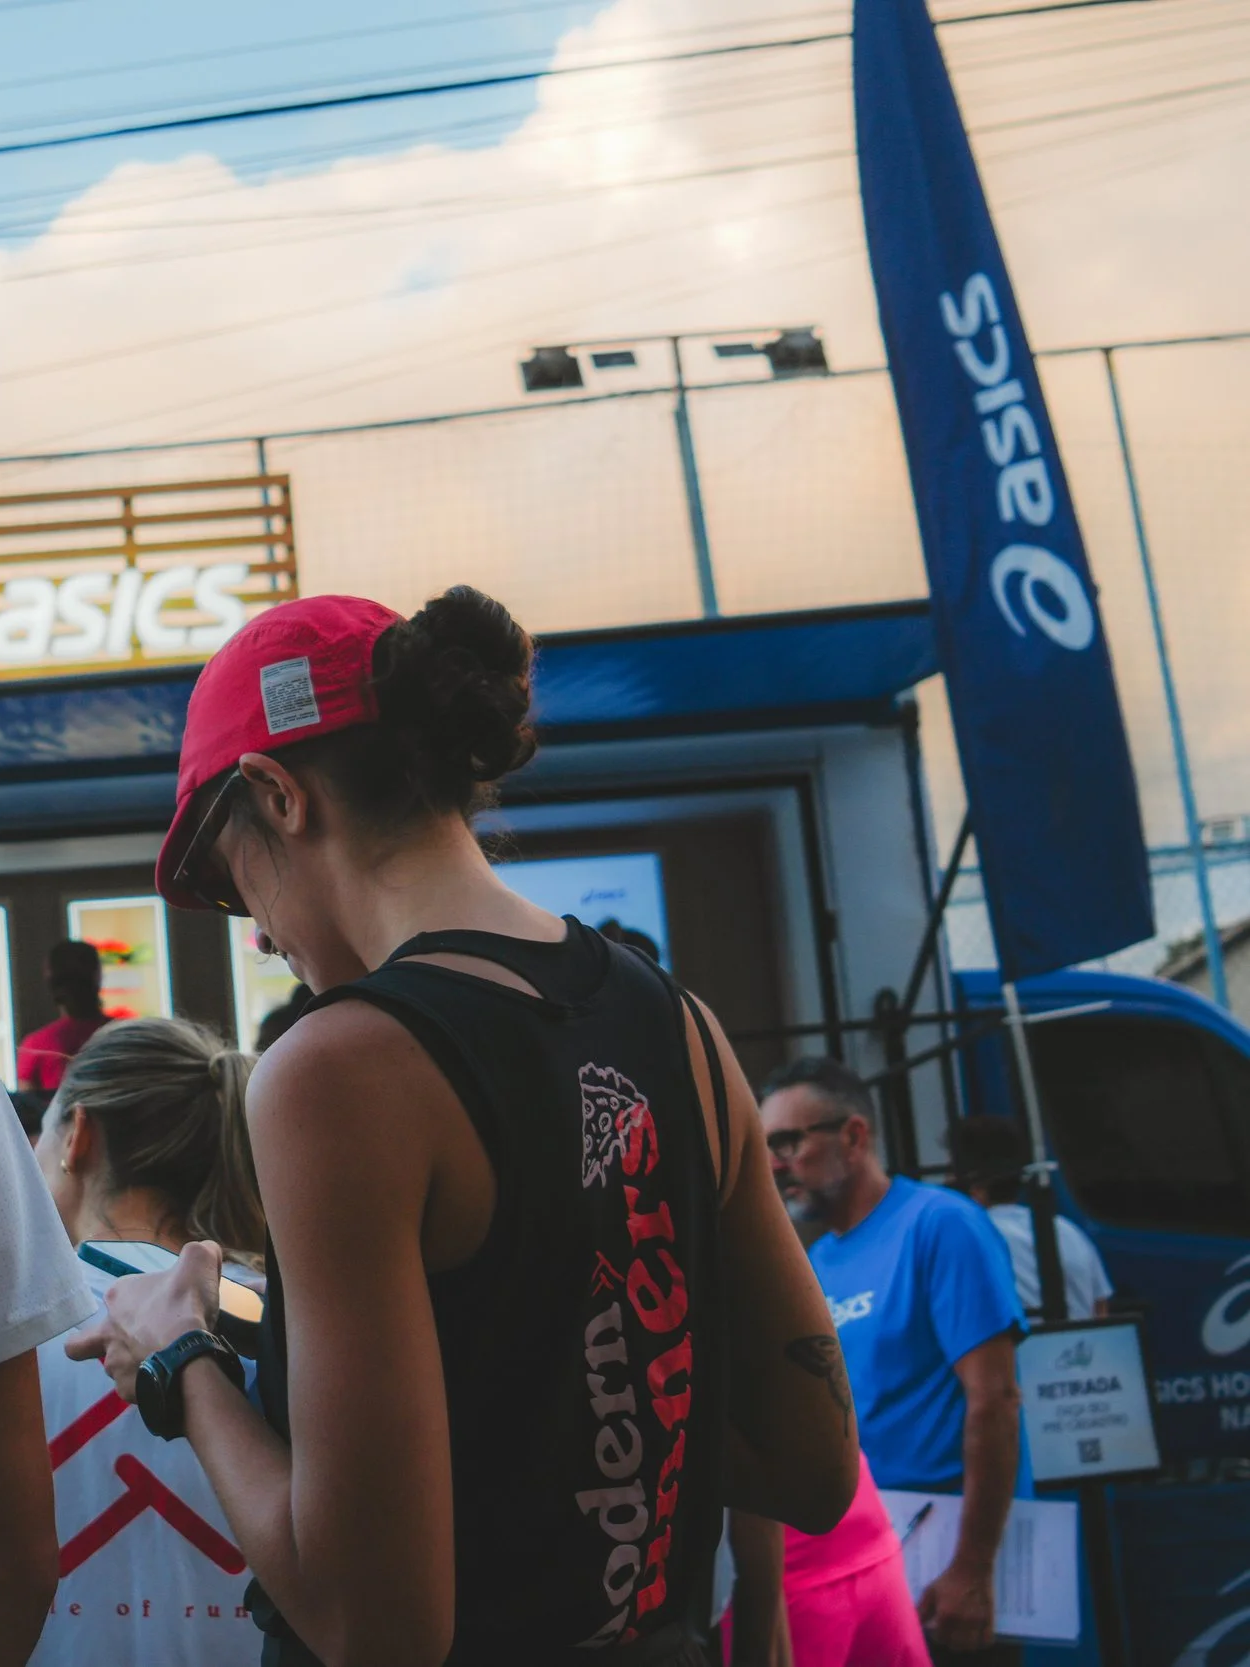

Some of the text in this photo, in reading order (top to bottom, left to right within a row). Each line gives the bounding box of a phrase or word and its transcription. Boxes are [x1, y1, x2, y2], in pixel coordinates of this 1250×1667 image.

[939, 272, 1054, 527] asics
[616, 1102, 693, 1646] unners
[1037, 1376, 1123, 1400] RETIRADA
[116, 1600, 150, 1618] of
